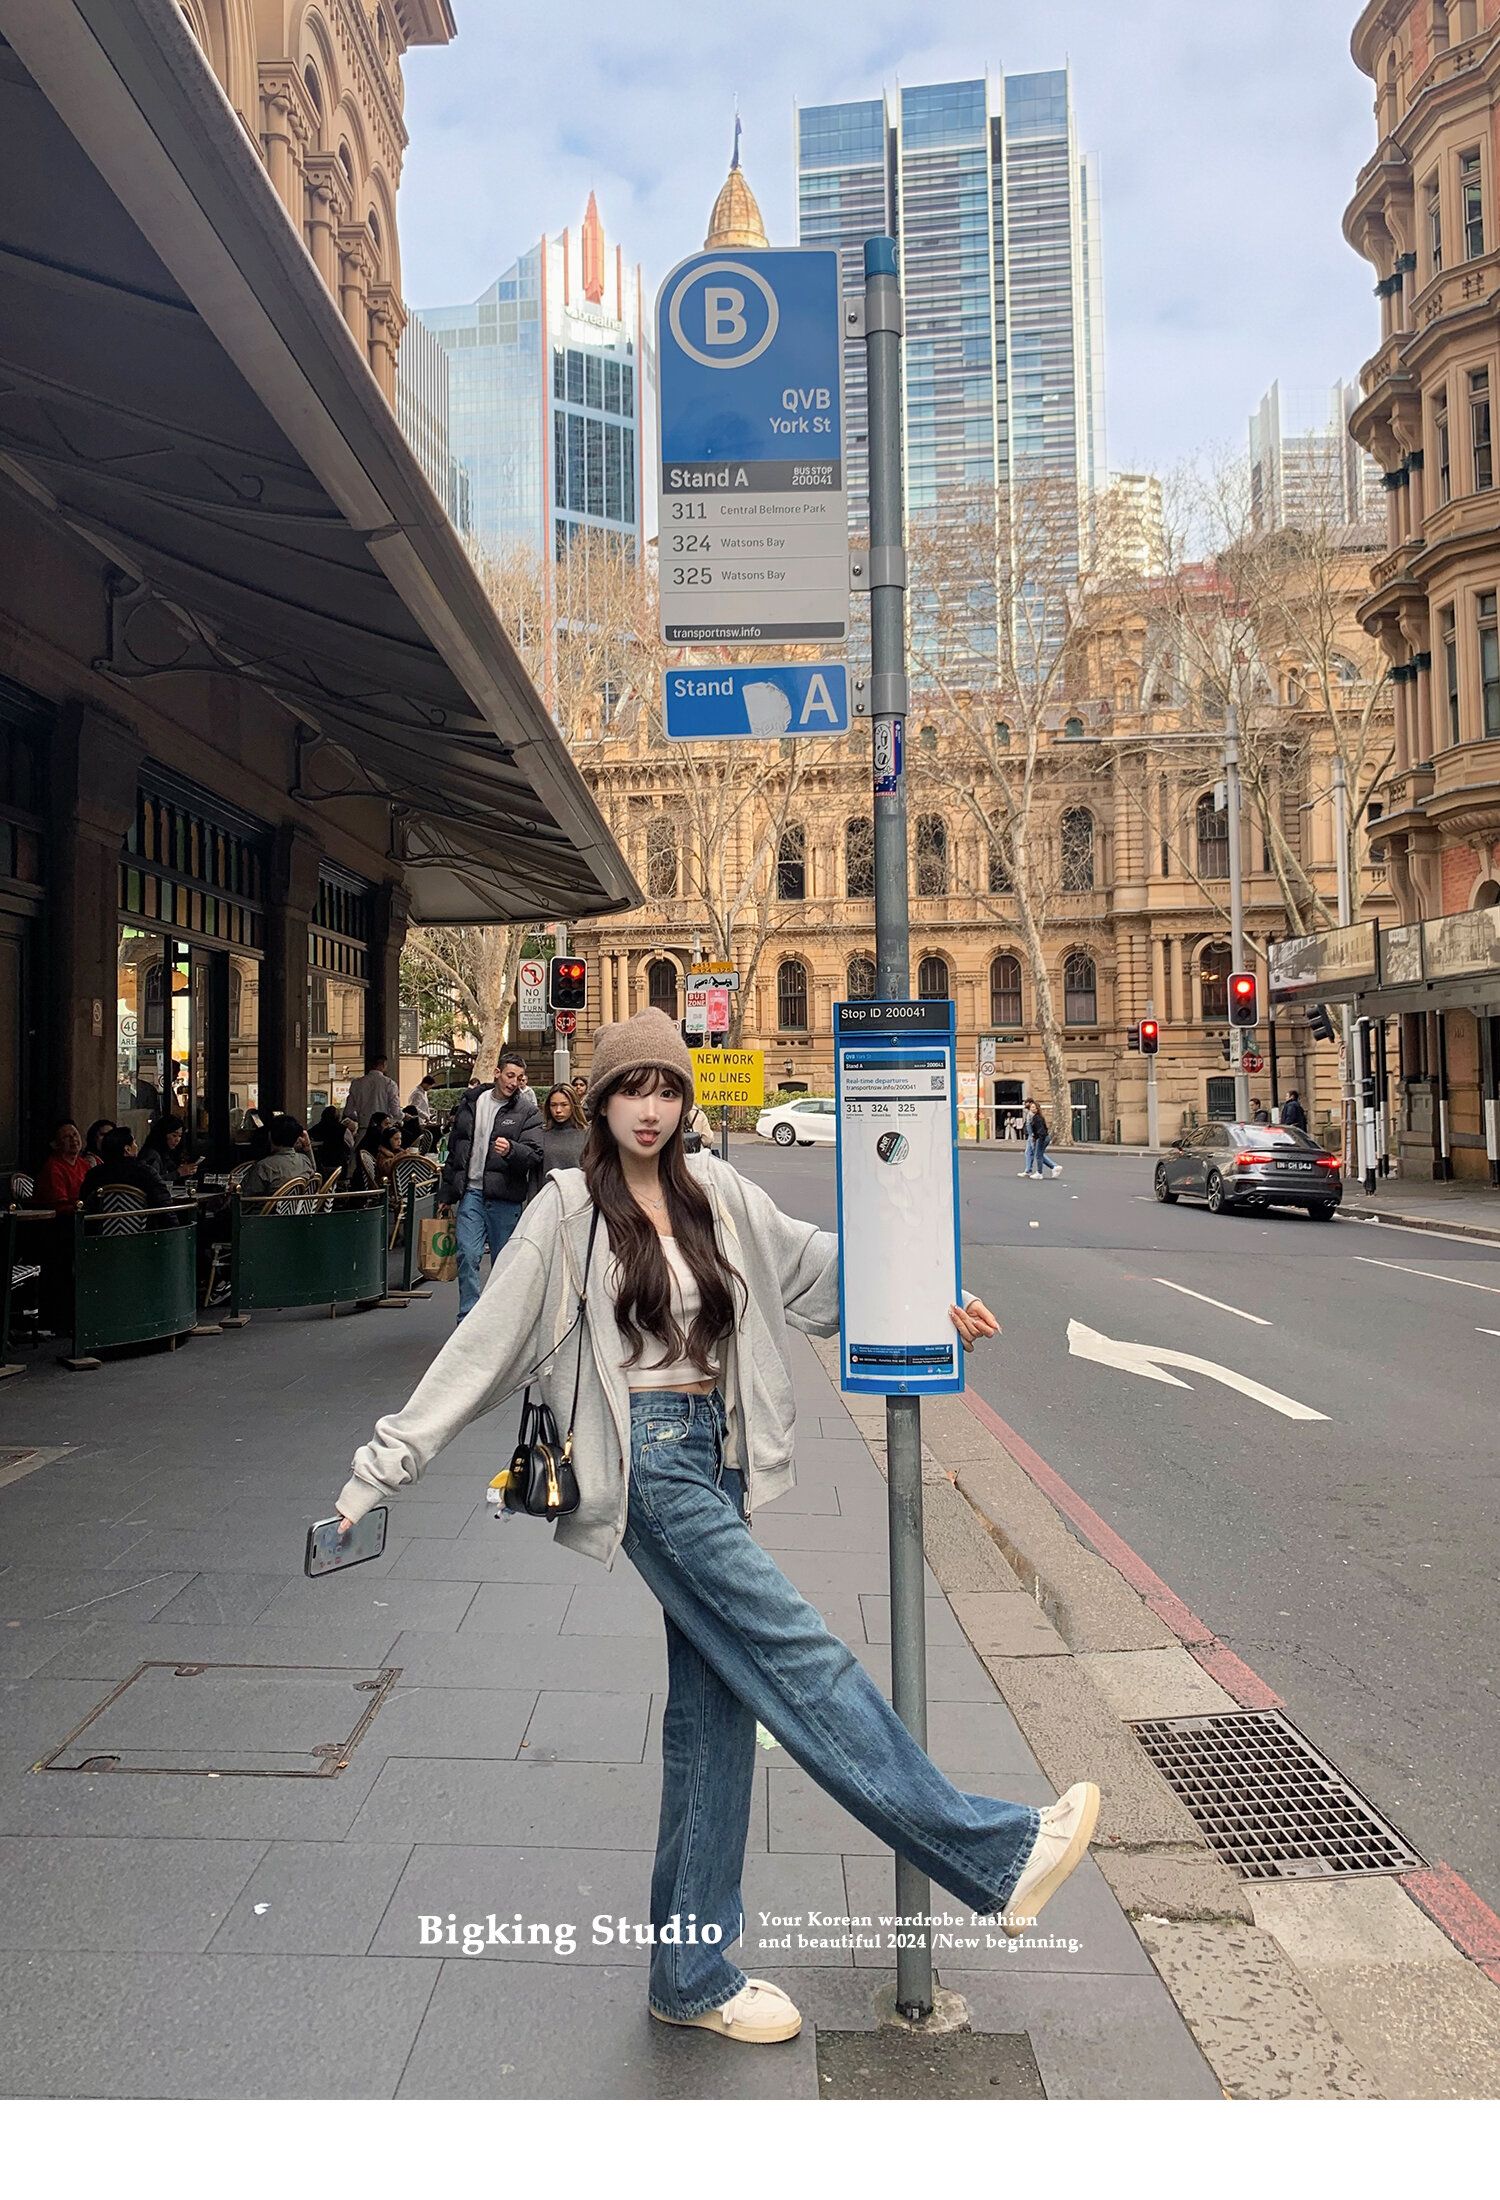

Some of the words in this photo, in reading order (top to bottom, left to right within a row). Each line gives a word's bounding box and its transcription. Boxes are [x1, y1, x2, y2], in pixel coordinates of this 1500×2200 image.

[704, 287, 748, 345] B
[782, 388, 830, 413] QVB
[769, 418, 810, 434] York
[813, 416, 832, 433] St
[794, 467, 811, 475] BUS
[812, 466, 832, 475] STOP
[670, 468, 729, 488] Stand
[734, 468, 749, 487] A
[792, 475, 832, 486] 200041
[672, 502, 708, 520] 311
[720, 504, 757, 516] Central
[760, 504, 801, 514] Belmore
[803, 503, 826, 513] Park
[672, 534, 712, 552] 324
[720, 538, 764, 548] Watsons
[766, 537, 786, 549] Bay
[672, 567, 712, 585] 325
[721, 570, 764, 581] Watsons
[767, 570, 786, 582] Bay
[672, 627, 761, 639] transportnsw.info
[674, 676, 734, 698] Stand
[800, 673, 839, 724] A
[526, 988, 539, 997] NO
[841, 1008, 866, 1020] Stop
[870, 1008, 881, 1018] ID
[886, 1008, 926, 1017] 200041
[558, 1018, 576, 1026] STOP
[697, 1054, 720, 1064] NEW
[724, 1054, 754, 1064] WORK
[1242, 1057, 1263, 1067] STOP
[700, 1072, 716, 1082] NO
[720, 1072, 751, 1083] LINES
[702, 1090, 748, 1102] MARKED
[846, 1104, 862, 1112] 311
[872, 1104, 888, 1112] 324
[898, 1104, 916, 1112] 325
